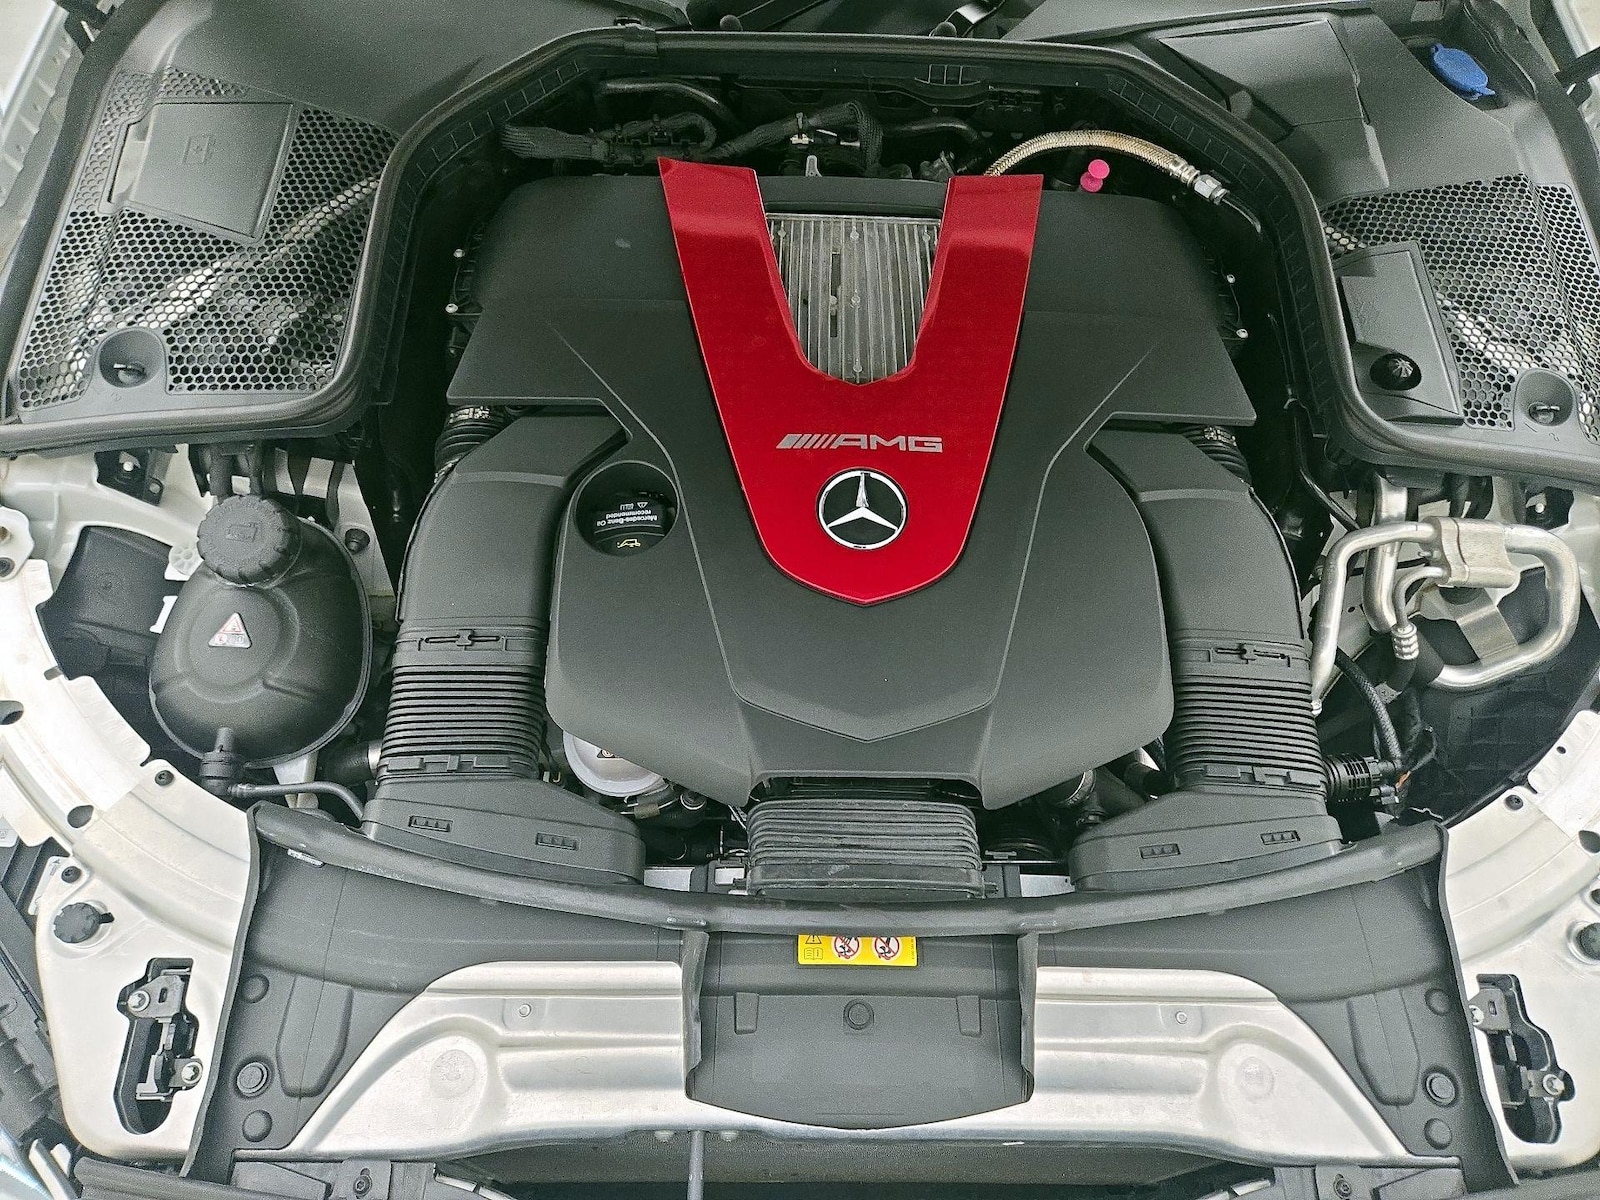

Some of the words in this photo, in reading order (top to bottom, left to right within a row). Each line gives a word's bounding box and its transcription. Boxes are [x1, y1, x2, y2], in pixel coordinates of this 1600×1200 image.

[829, 433, 943, 453] AMG
[606, 510, 651, 519] recommended
[607, 515, 657, 525] Mercedes-Benz
